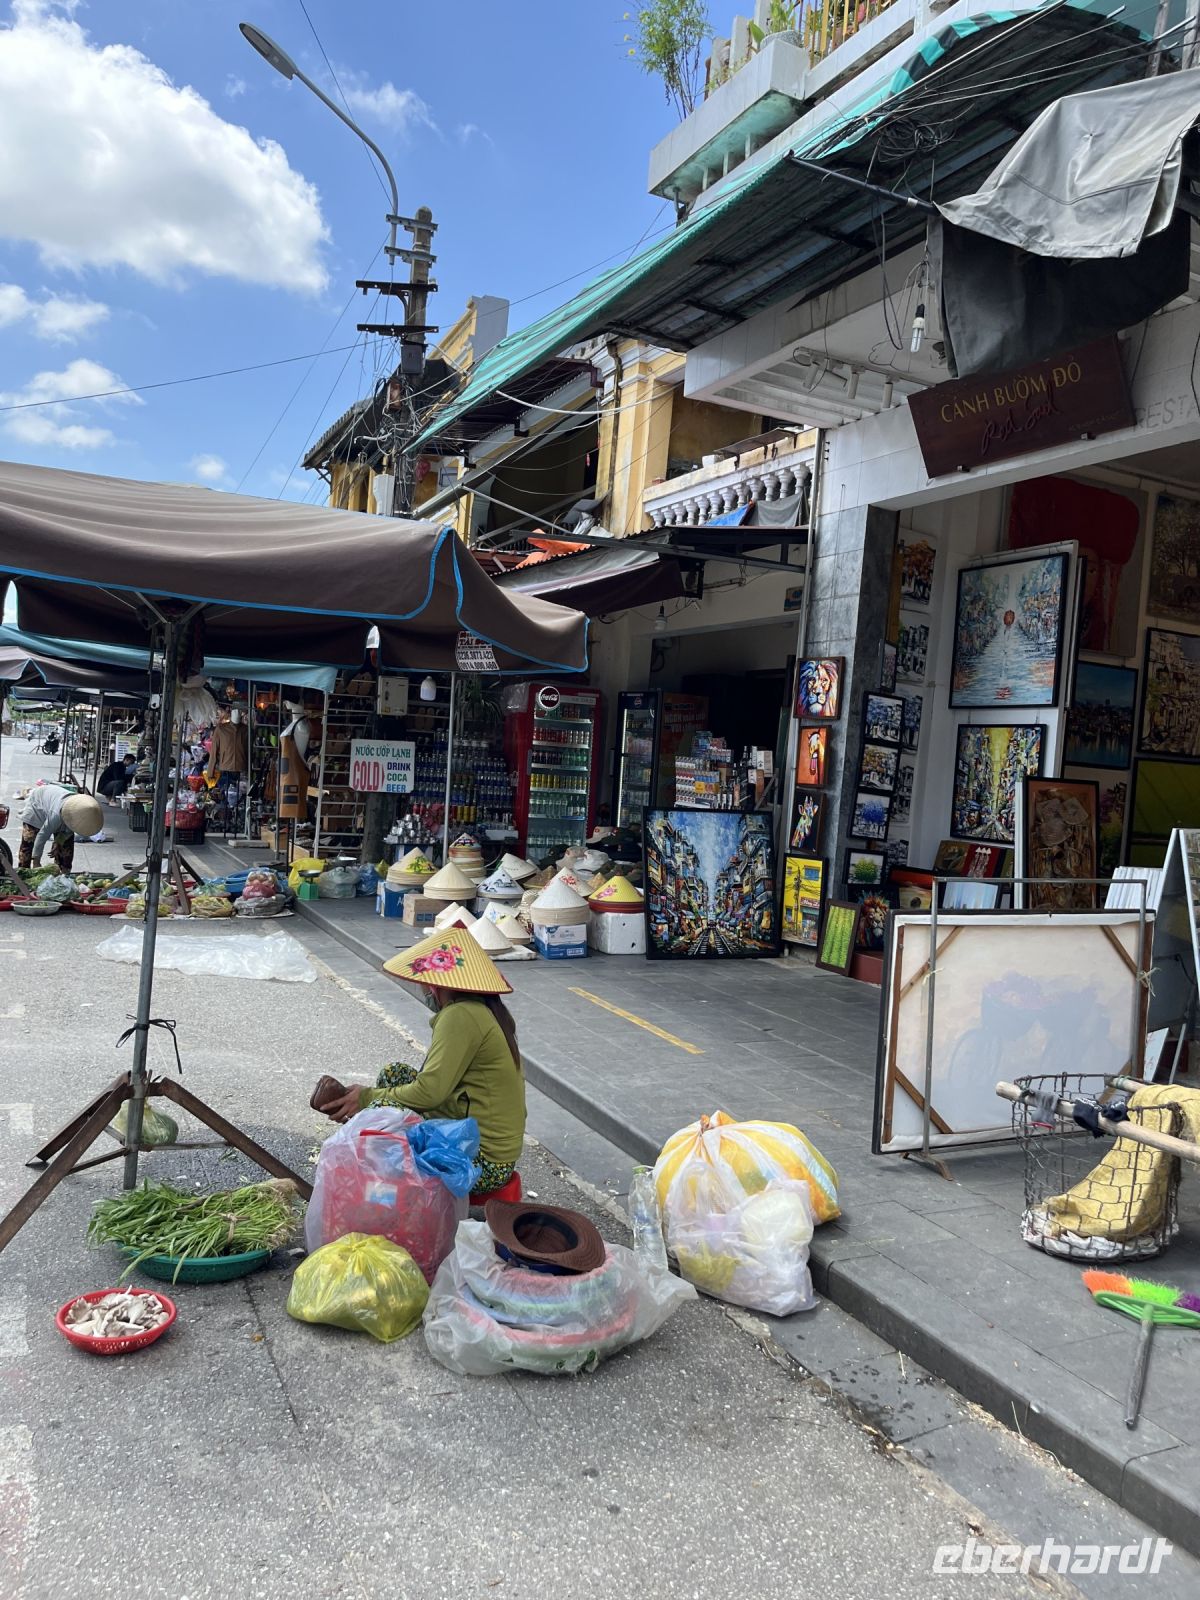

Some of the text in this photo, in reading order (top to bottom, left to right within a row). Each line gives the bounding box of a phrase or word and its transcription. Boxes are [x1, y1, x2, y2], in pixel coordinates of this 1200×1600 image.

[941, 355, 1081, 423] CÁNH BƯỜM ĐỎ
[392, 747, 411, 760] LẠNH
[387, 762, 411, 771] DRINK
[353, 760, 380, 791] COLD
[386, 773, 408, 782] COCA
[386, 784, 407, 793] BEER
